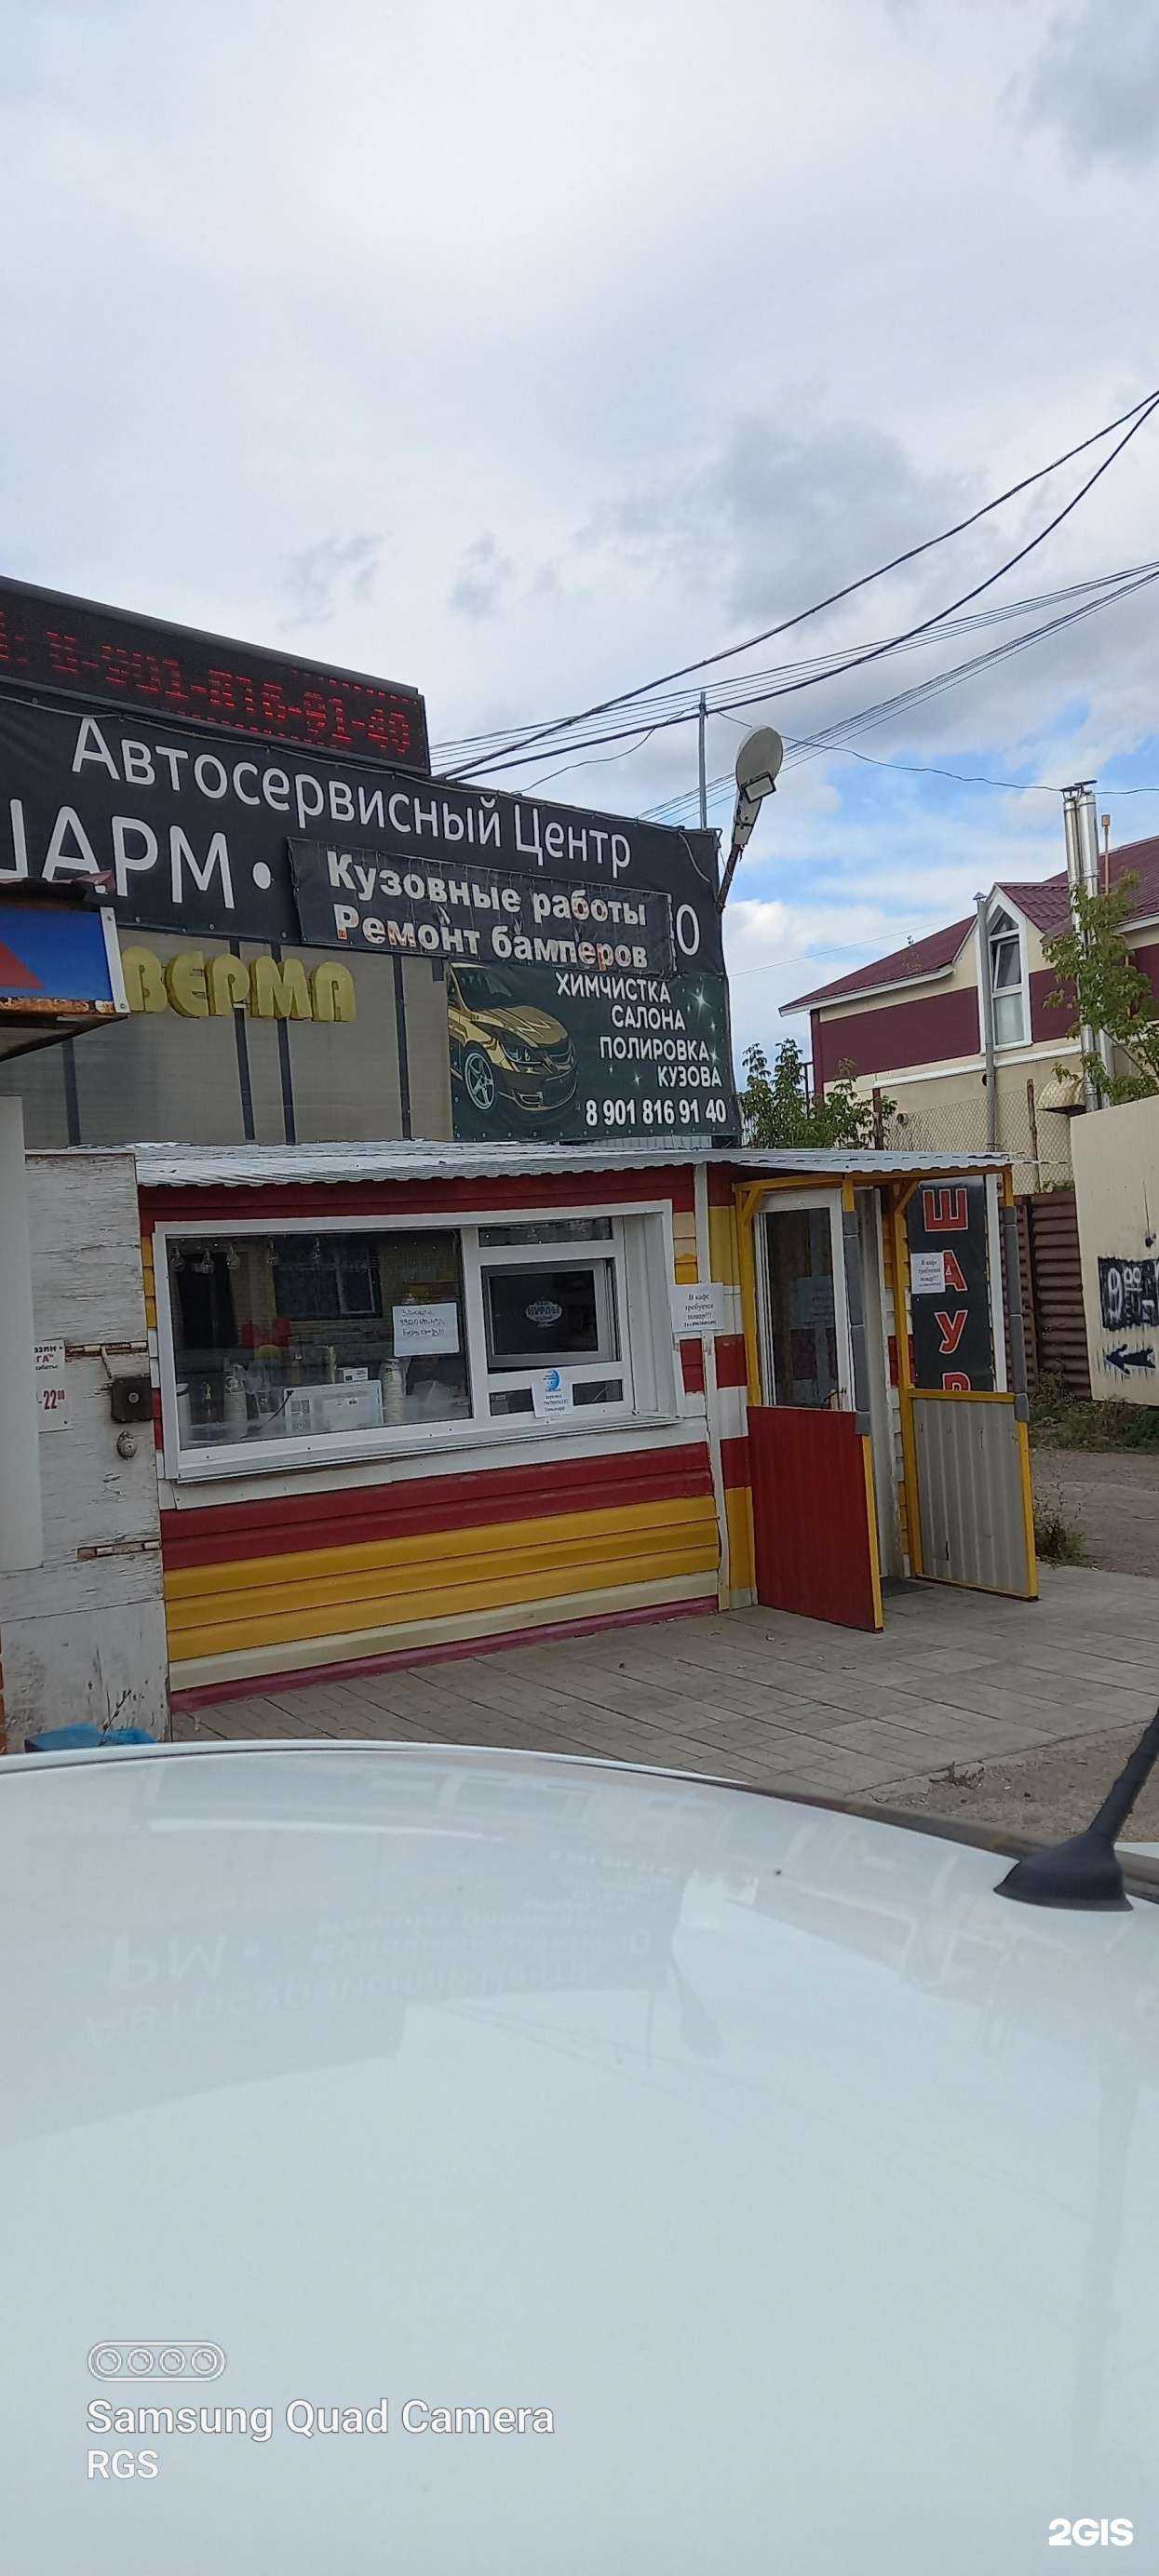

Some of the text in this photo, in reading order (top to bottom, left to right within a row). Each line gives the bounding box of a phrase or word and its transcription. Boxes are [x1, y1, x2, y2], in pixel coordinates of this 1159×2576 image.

[72, 717, 631, 879] Автосервисный Центр
[327, 850, 646, 926] Кузовные работы
[333, 904, 648, 972] Ремонт бамперов
[556, 972, 671, 1004] ХИМЧИСТКА
[612, 1005, 685, 1031] САЛОНА
[600, 1036, 709, 1061] ПОЛИРОВКА
[657, 1065, 722, 1089] КУЗОВА
[586, 1099, 727, 1126] 8 901 816 91 40
